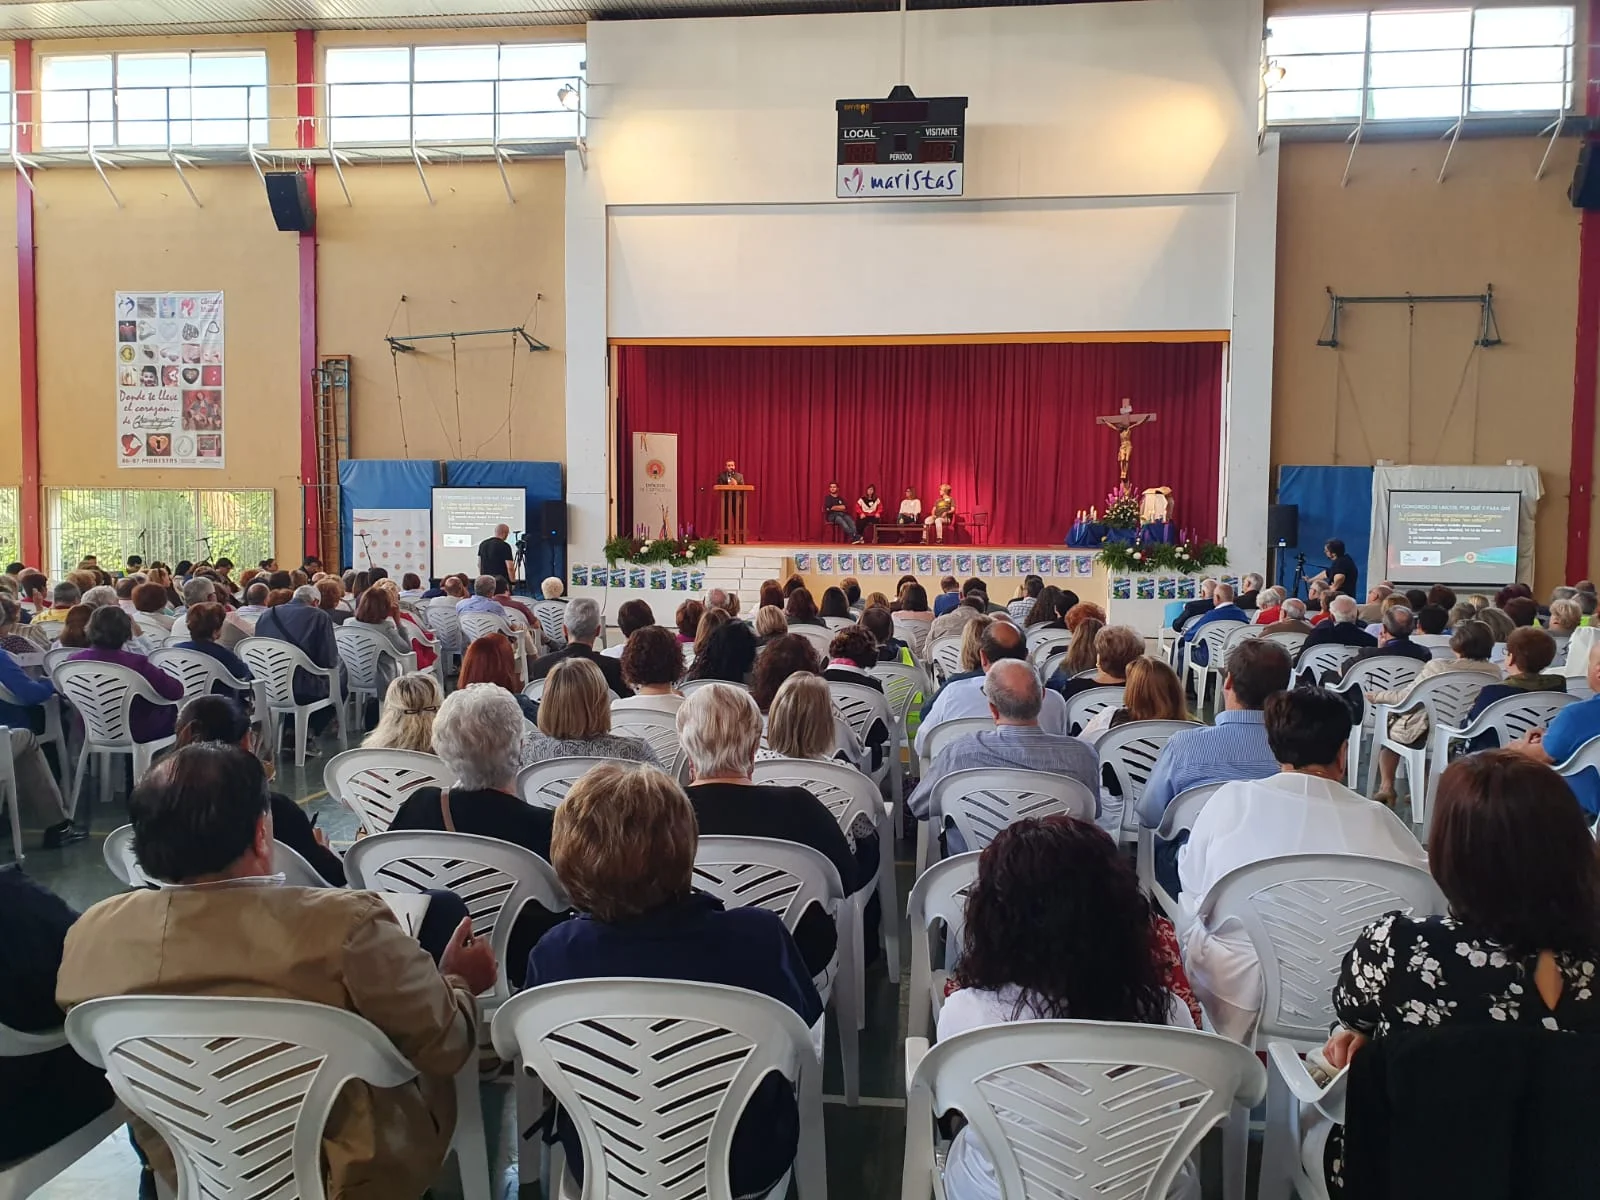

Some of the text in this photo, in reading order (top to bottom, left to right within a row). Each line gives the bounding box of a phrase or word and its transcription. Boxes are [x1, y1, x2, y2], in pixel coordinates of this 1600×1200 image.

[844, 129, 877, 138] LOCAL
[925, 127, 958, 136] VISITANTE
[889, 153, 912, 161] PERIODO
[870, 168, 957, 190] maristas
[120, 389, 178, 401] Donde te lleve
[123, 402, 133, 412] el
[122, 416, 131, 425] de
